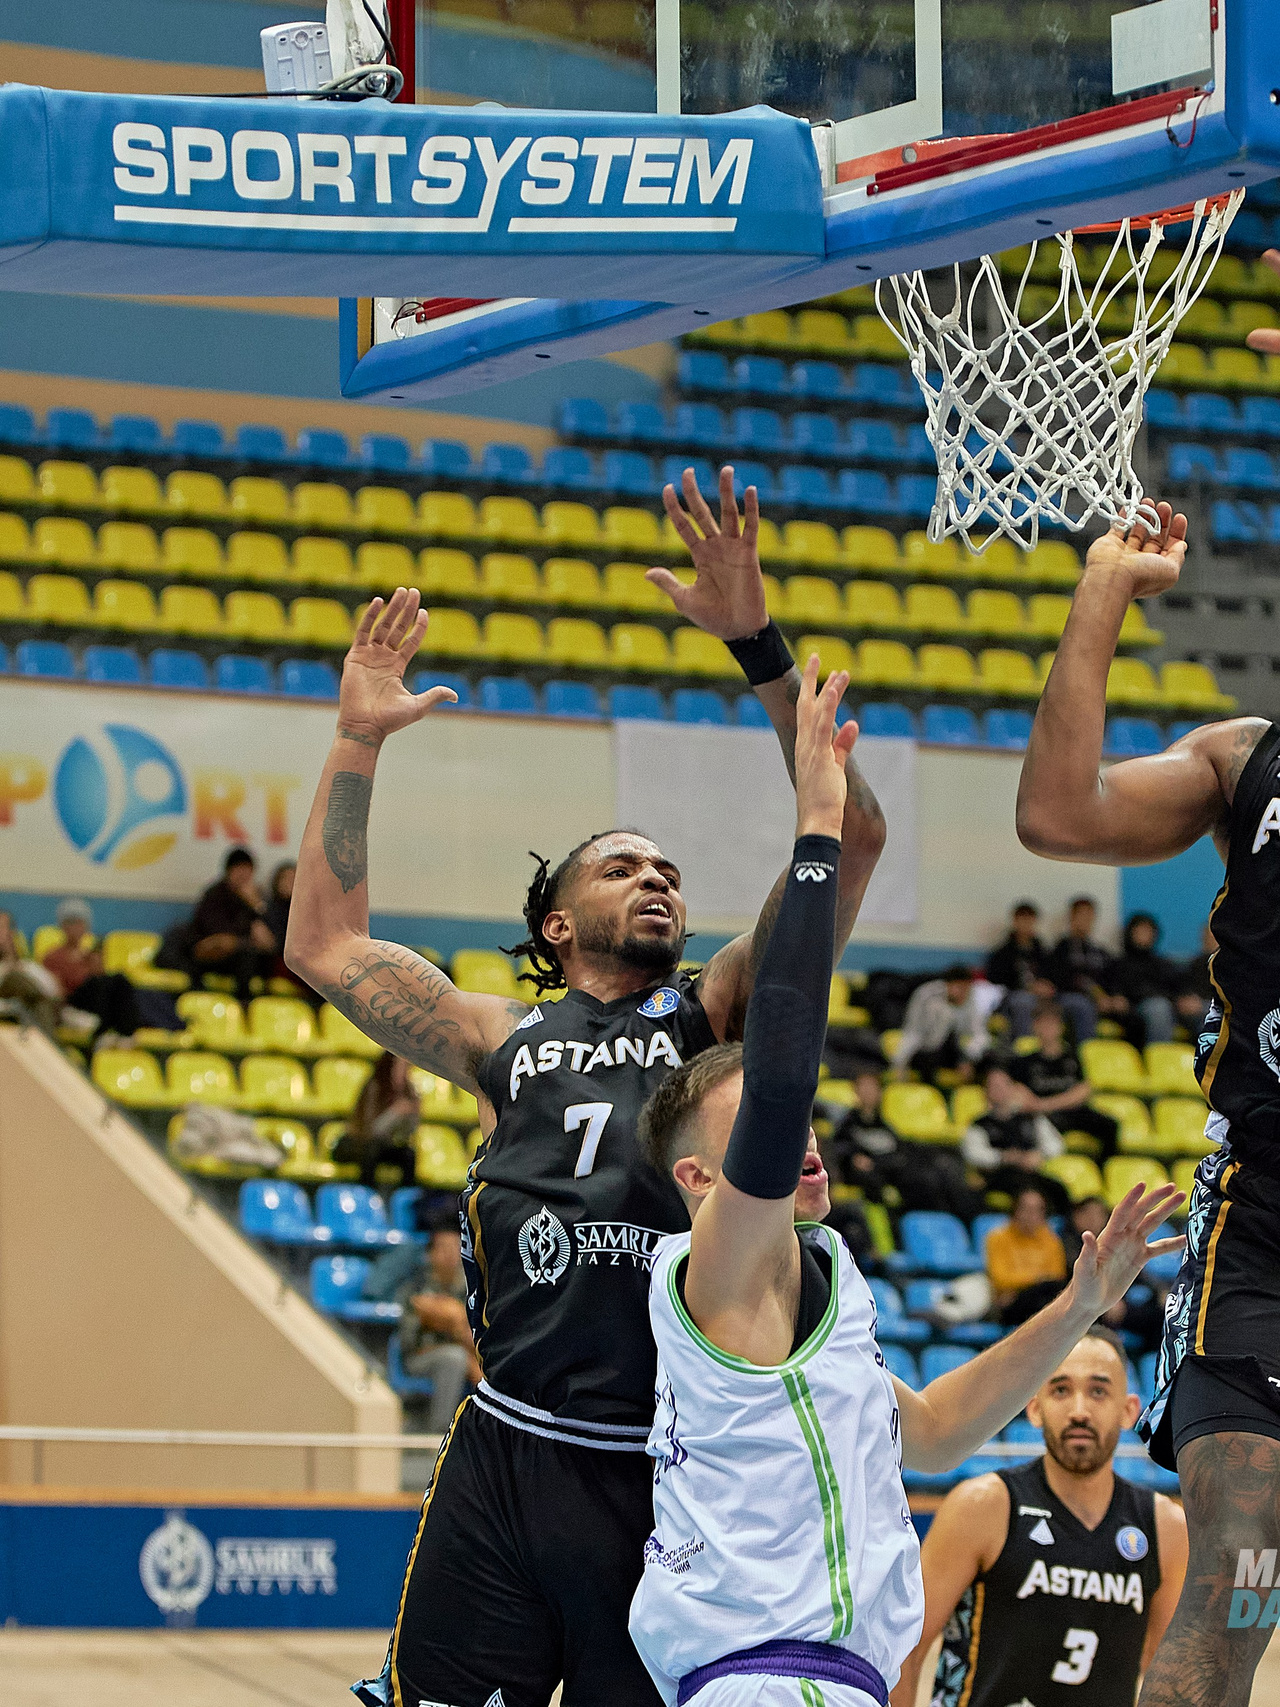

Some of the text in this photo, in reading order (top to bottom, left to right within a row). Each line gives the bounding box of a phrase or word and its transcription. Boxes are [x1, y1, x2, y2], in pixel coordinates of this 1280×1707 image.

[509, 1030, 685, 1102] ASTANA
[564, 1101, 614, 1181] 7
[574, 1225, 663, 1256] SAMRU
[576, 1252, 652, 1273] KAZYN
[1016, 1559, 1145, 1616] ASTANA
[1050, 1627, 1100, 1686] 3
